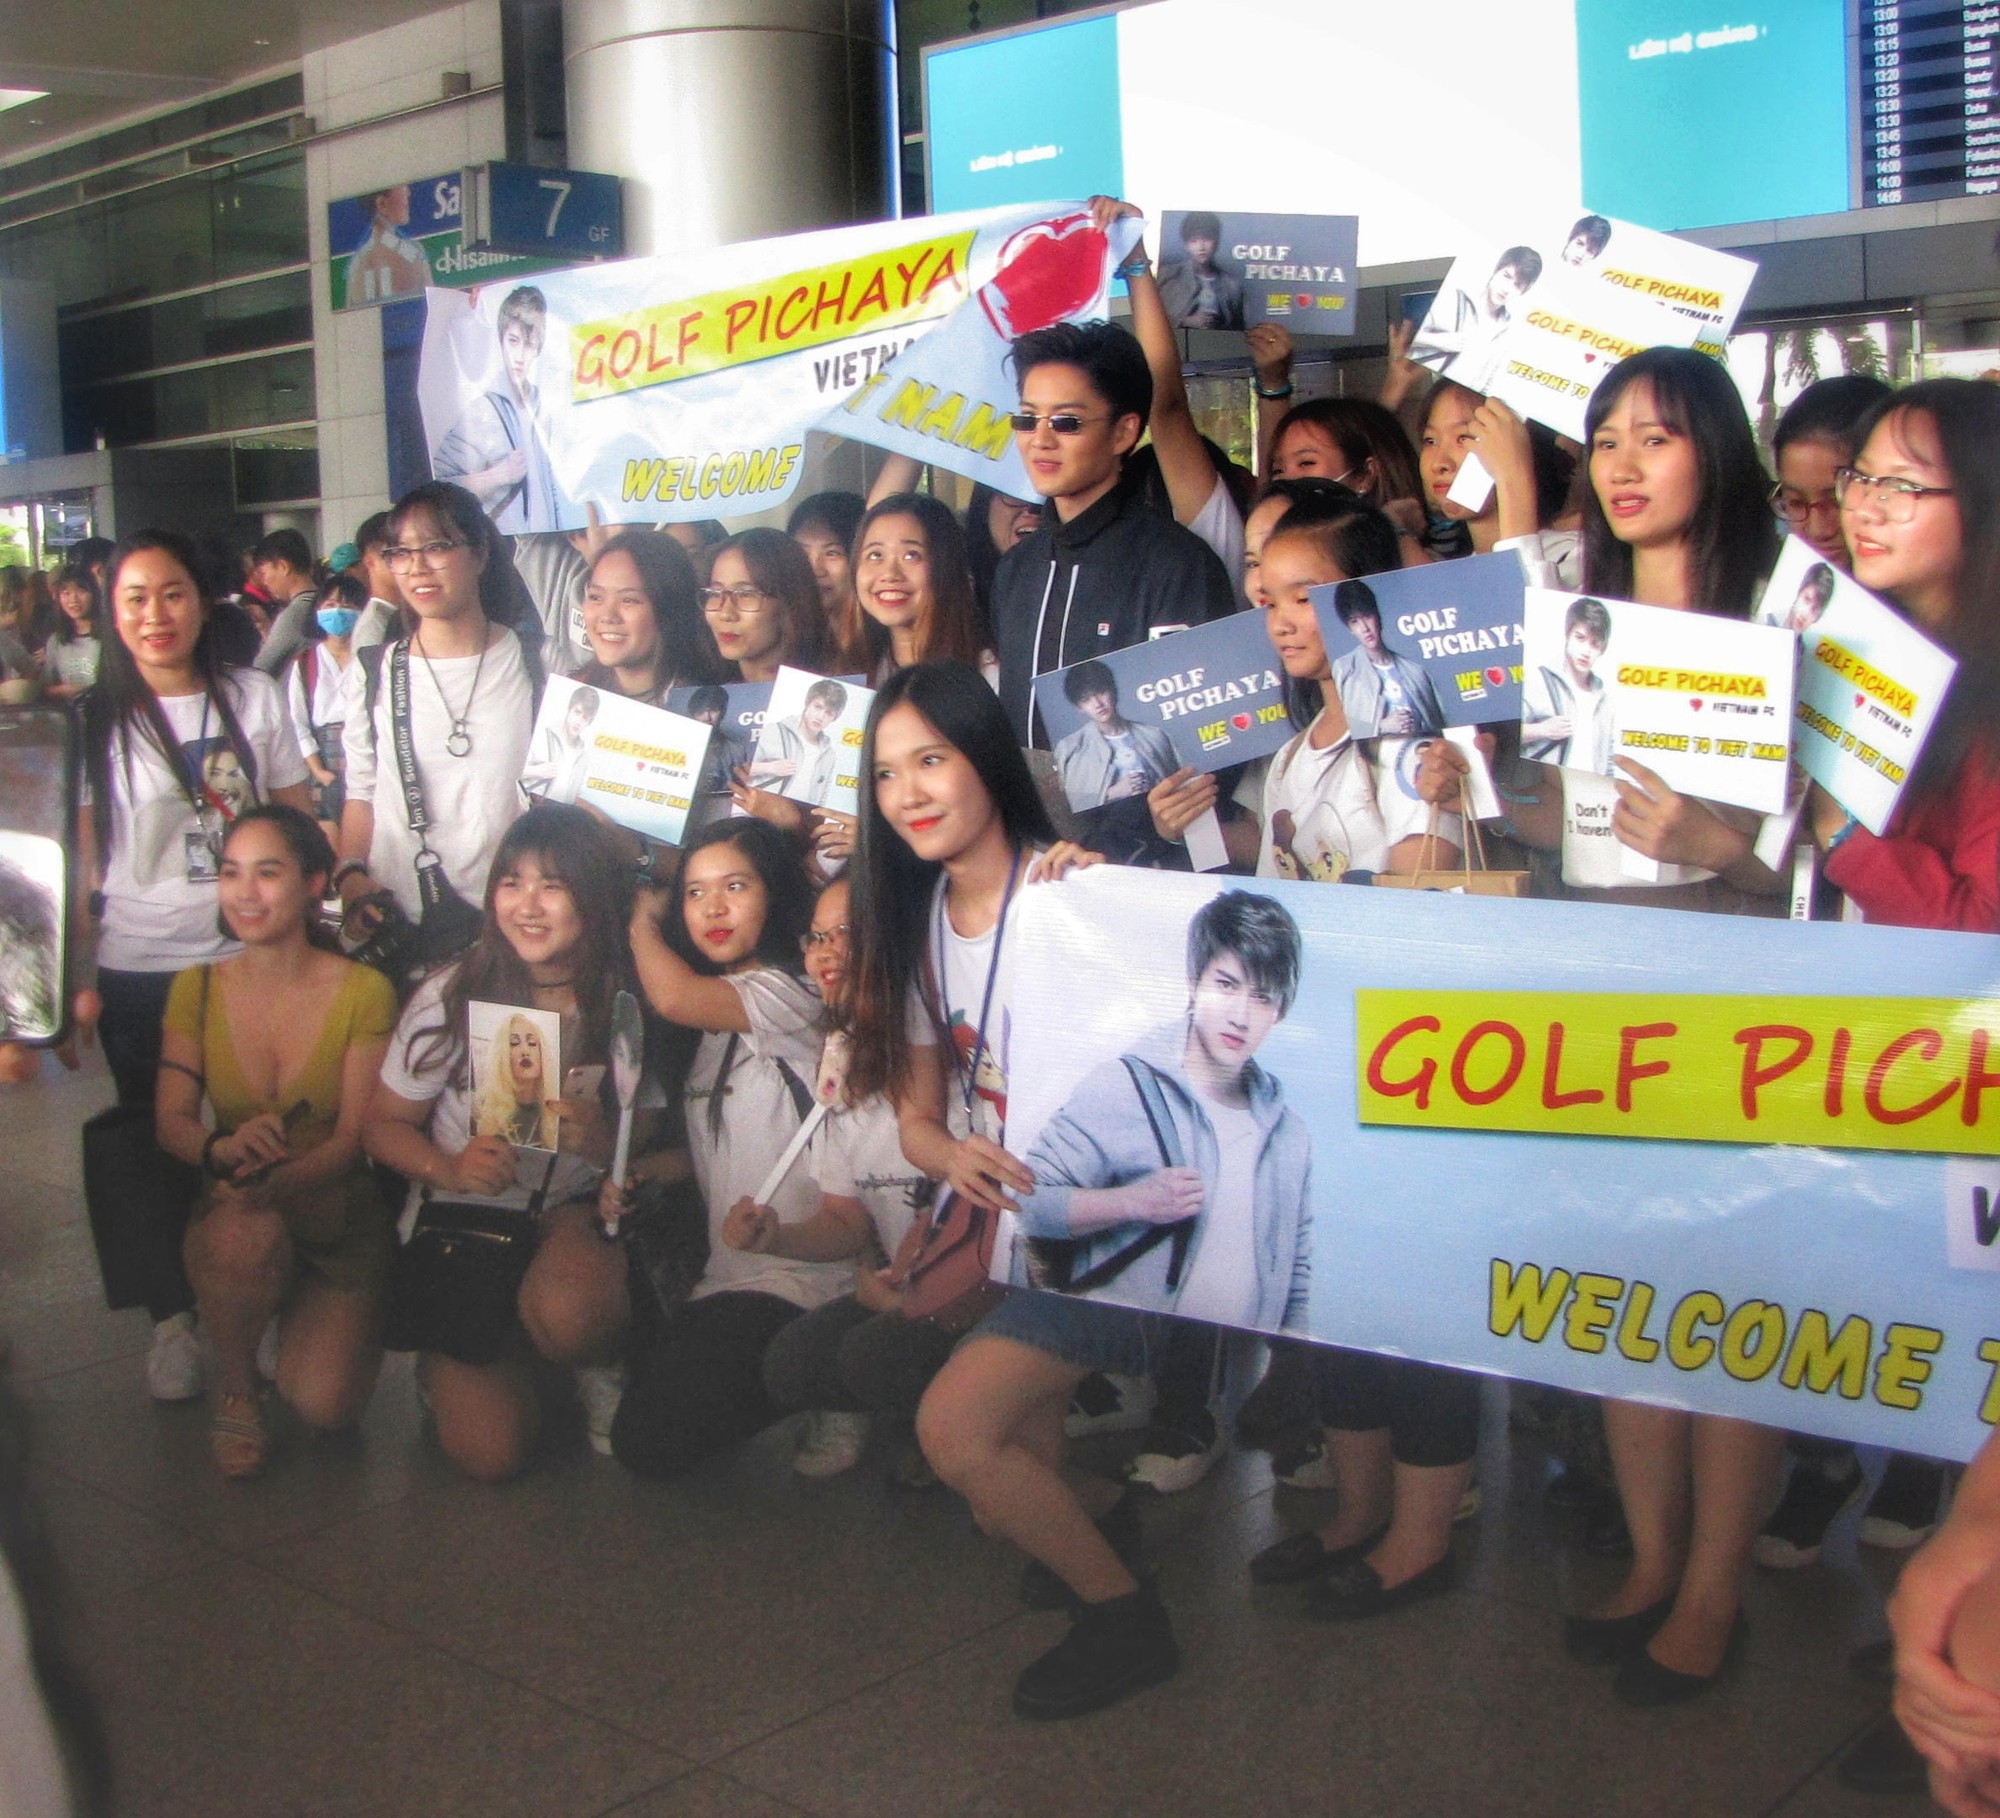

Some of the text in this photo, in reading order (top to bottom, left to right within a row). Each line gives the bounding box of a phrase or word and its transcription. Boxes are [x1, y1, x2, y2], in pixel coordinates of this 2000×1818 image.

[1874, 6, 1898, 22] 13:00
[1874, 22, 1898, 37] 13:00
[1874, 37, 1898, 53] 13:15
[1874, 52, 1899, 68] 13:20
[1874, 68, 1899, 83] 13:20
[1875, 83, 1899, 98] 13:25
[1875, 98, 1900, 113] 13:30
[1875, 113, 1900, 128] 13:30
[1876, 159, 1901, 174] 14:00
[1876, 174, 1901, 189] 14:00
[433, 181, 461, 219] Sa
[538, 178, 572, 238] 7
[1876, 189, 1901, 204] 14:05
[588, 225, 611, 242] GF
[1231, 244, 1292, 261] GOLF
[1244, 263, 1346, 283] PICHAYA
[1648, 280, 1721, 310] PICHAYA
[576, 247, 962, 388] GOLF PICHAYA
[1525, 310, 1648, 358] GOLF PICHA
[1507, 359, 1591, 401] WELCOME TO
[622, 444, 802, 503] WELCOME
[1397, 607, 1458, 636] GOLF
[1418, 623, 1524, 660] PICHAYA
[396, 669, 407, 717] Fashion
[1136, 667, 1206, 703] GOLF
[1455, 670, 1484, 691] WE
[1617, 667, 1766, 698] GOLF PICHAYA
[1816, 642, 1913, 718] GOLF PICHAYA
[1159, 669, 1282, 720] PICHAYA
[1713, 702, 1758, 715] VIETNAM
[738, 711, 768, 726] GO
[1198, 719, 1228, 743] WE
[1868, 704, 1902, 731] VIETNAM
[594, 735, 687, 766] GOLF PICHAYA
[1621, 729, 1690, 752] WELCOME
[1692, 736, 1712, 754] TO
[1715, 738, 1749, 758] VIET
[1840, 730, 1857, 752] TO
[1854, 740, 1881, 767] VIET
[1876, 756, 1906, 785] NAM
[1366, 1015, 2000, 1127] GOLF PICH
[1488, 1257, 1944, 1411] WELCOME
